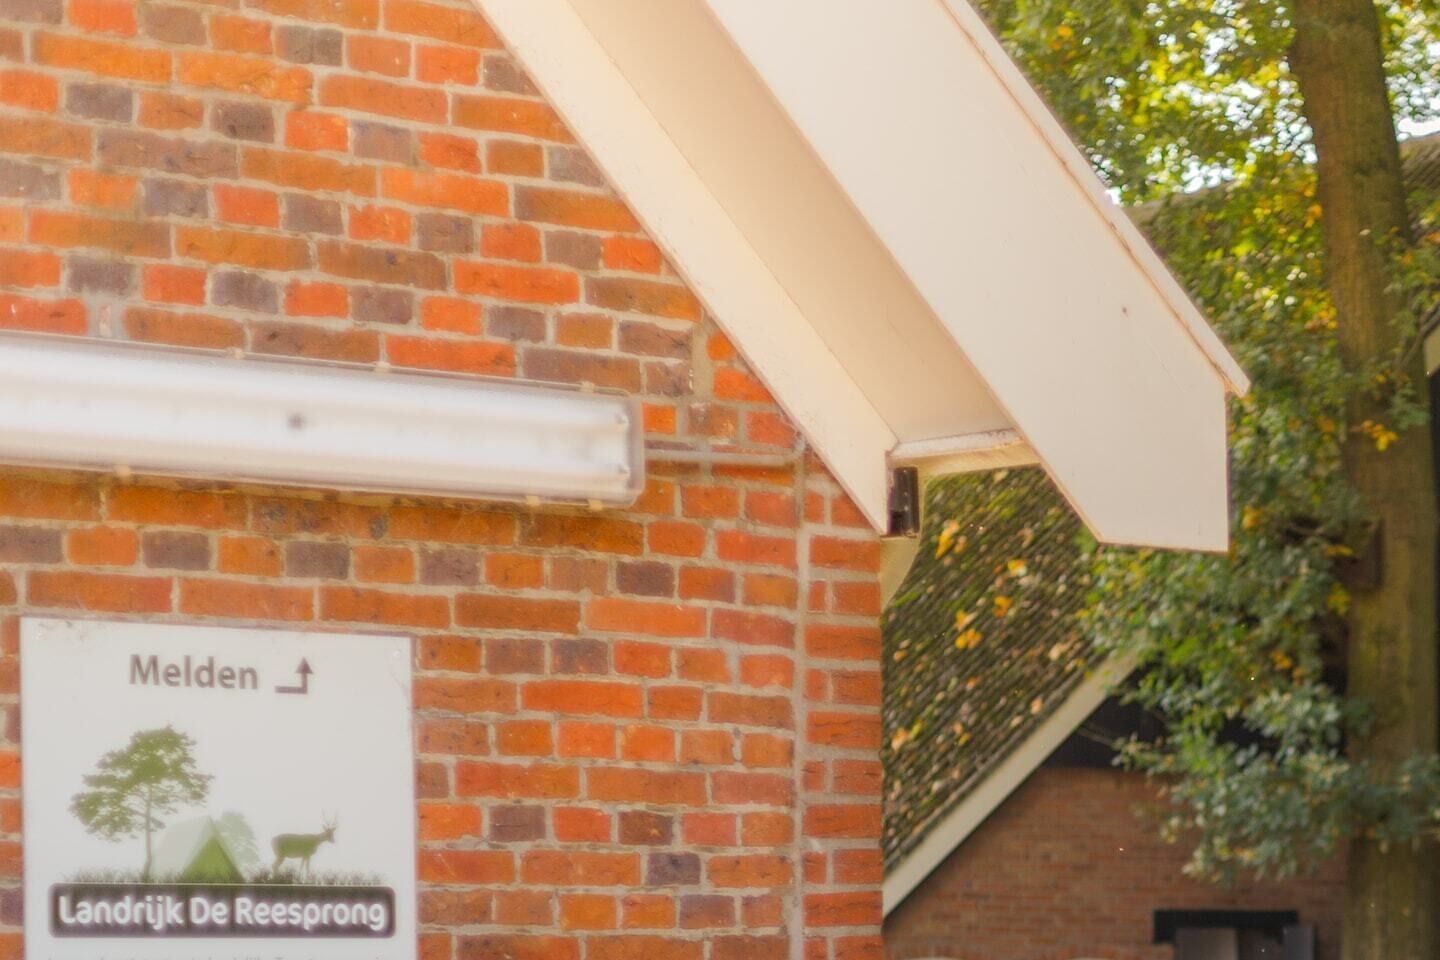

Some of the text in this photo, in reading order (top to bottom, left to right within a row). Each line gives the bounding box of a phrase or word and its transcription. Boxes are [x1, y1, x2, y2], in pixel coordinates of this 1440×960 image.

[129, 653, 259, 690] Melden
[59, 896, 386, 931] Landrijk De Reesprong
